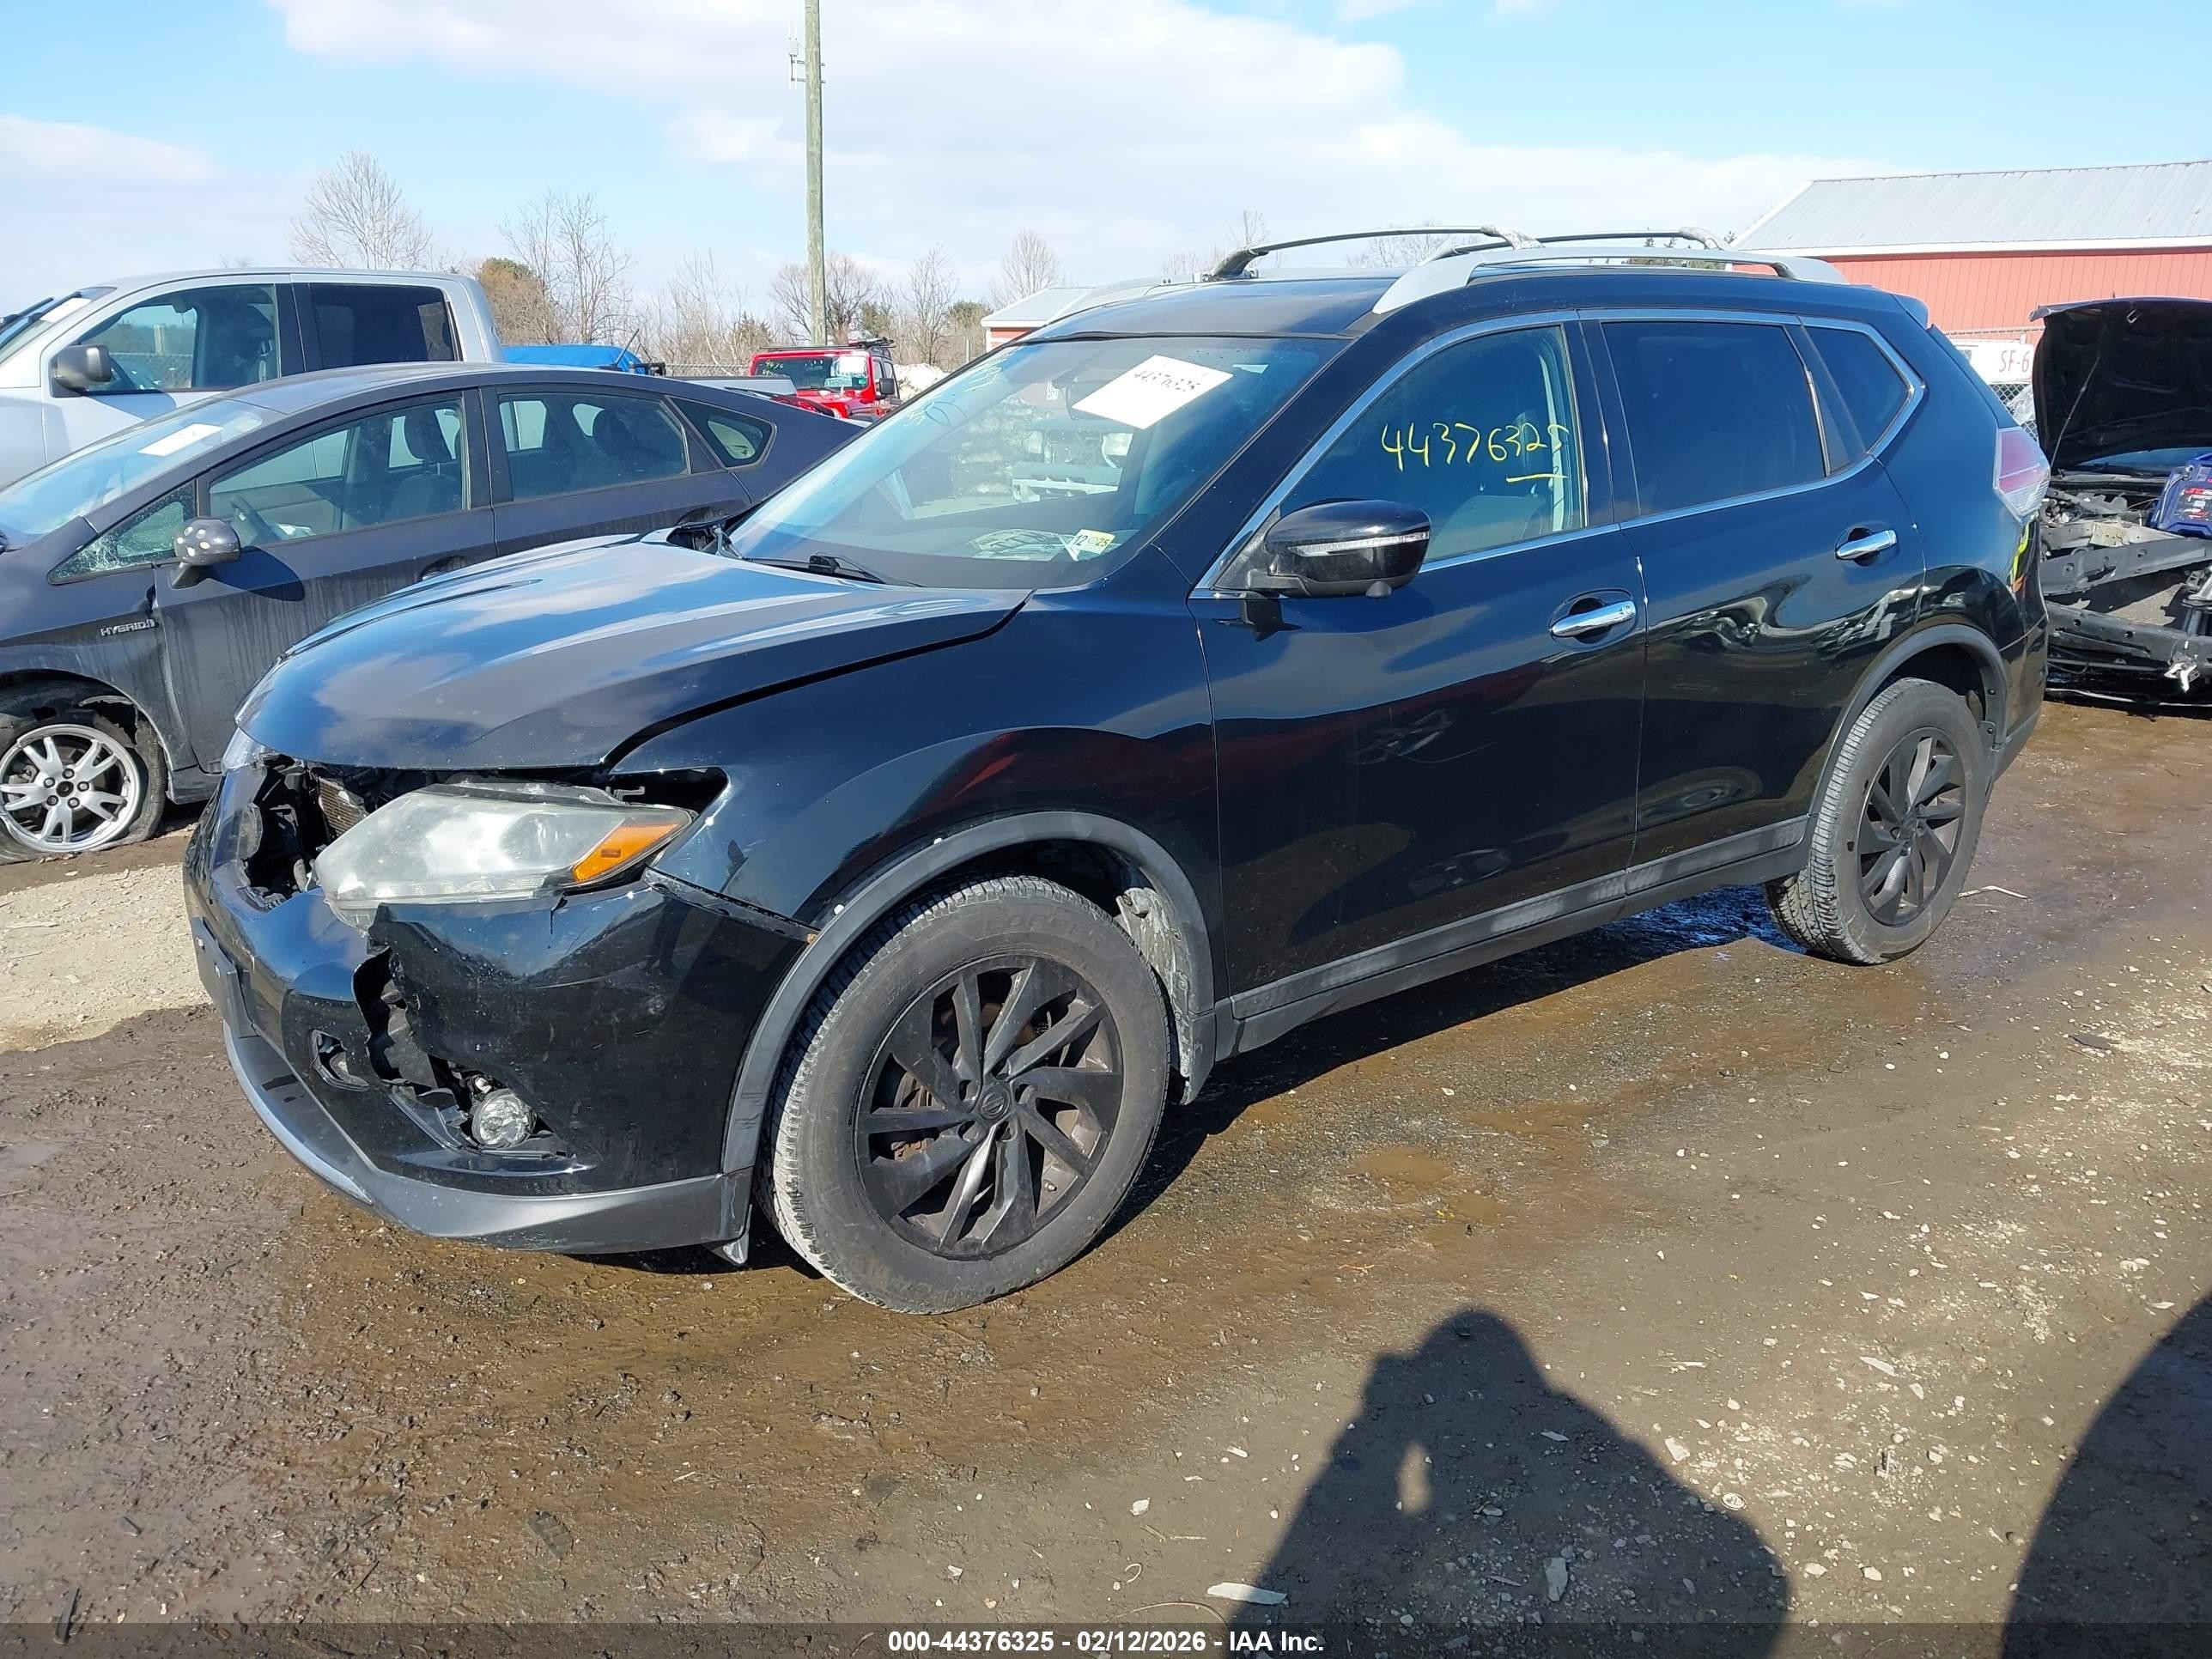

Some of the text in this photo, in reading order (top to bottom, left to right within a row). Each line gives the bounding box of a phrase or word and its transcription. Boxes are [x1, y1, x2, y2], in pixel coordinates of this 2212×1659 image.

[1999, 349, 2030, 373] SF-6
[1381, 422, 1570, 472] 44376325
[1073, 534, 1110, 547] 12 25
[100, 620, 147, 636] HYBRID
